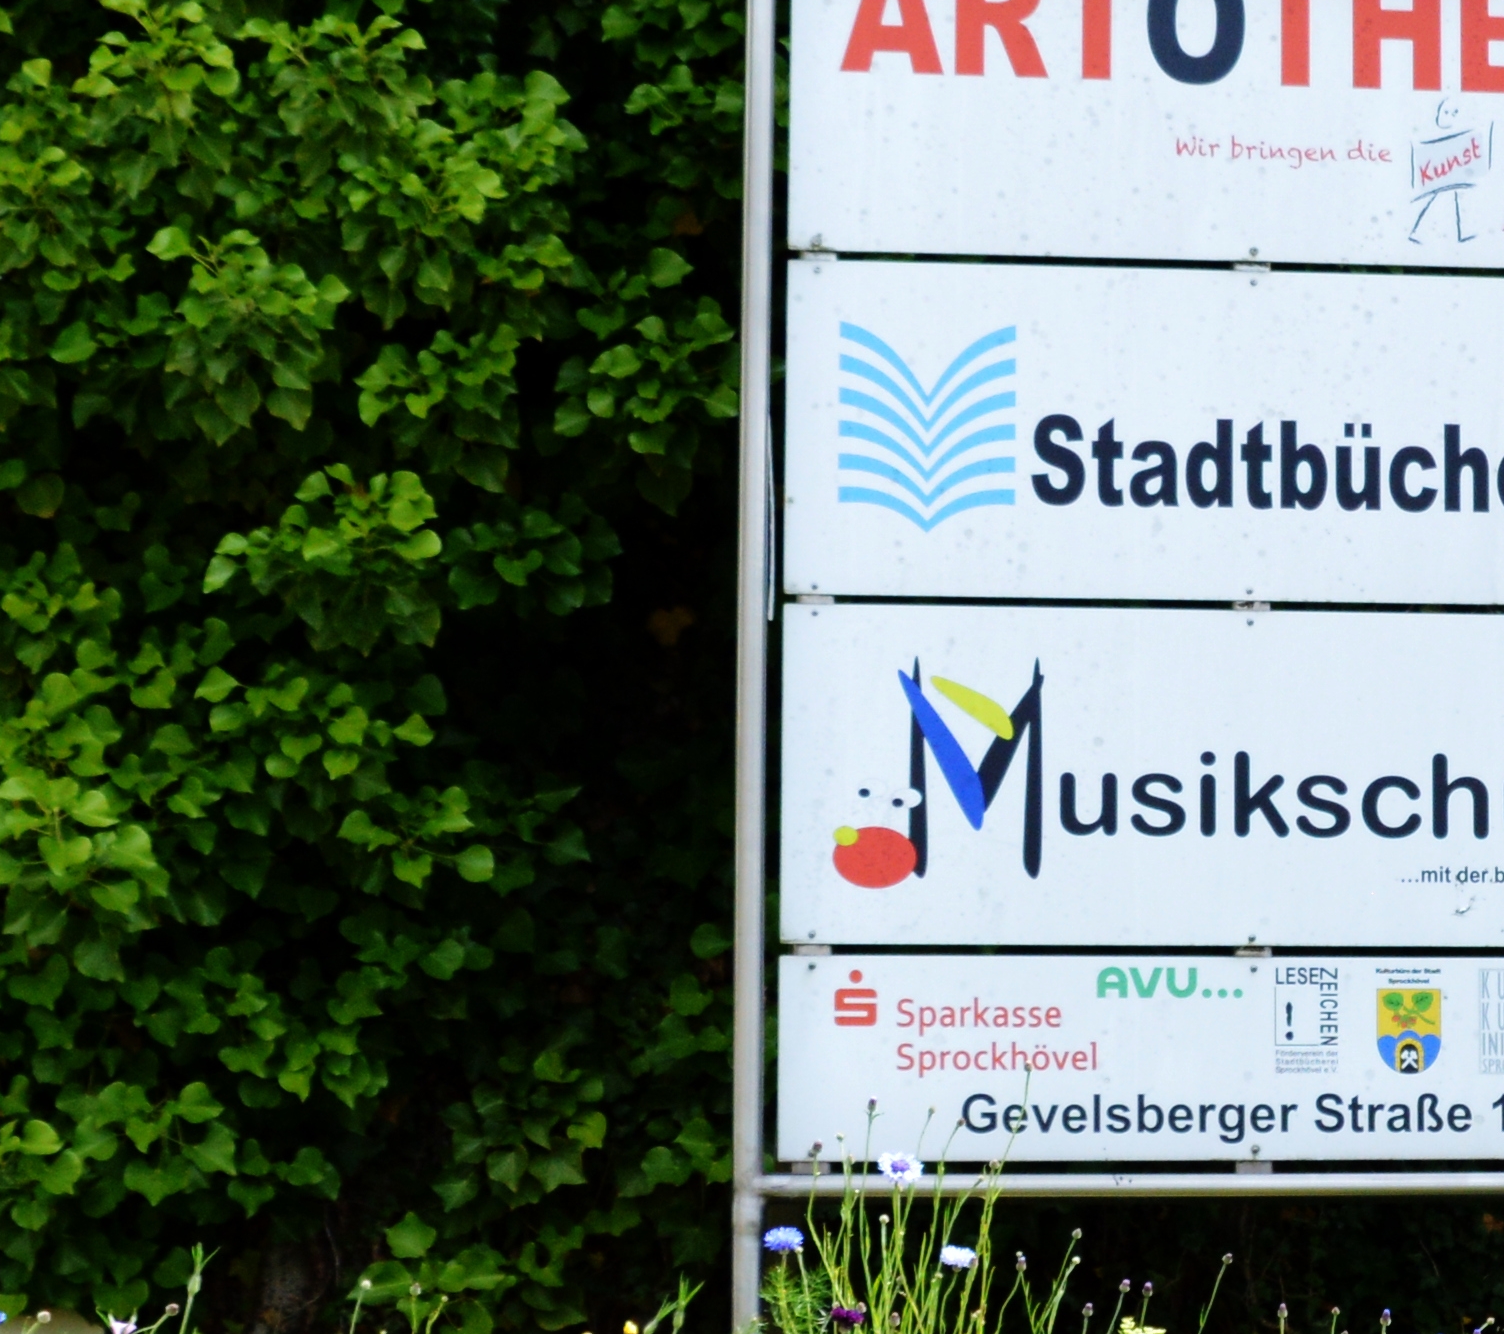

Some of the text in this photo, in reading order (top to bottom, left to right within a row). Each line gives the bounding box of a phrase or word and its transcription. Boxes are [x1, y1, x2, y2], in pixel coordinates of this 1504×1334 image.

[1176, 135, 1392, 169] Wir bringen die
[1420, 135, 1481, 186] Kunst
[1456, 866, 1488, 884] der
[1276, 967, 1319, 985] LESE
[1388, 977, 1430, 986] Sprockhövel
[897, 997, 1061, 1036] Sparkasse
[1319, 968, 1338, 1045] ZEICHEN
[897, 1042, 1098, 1077] Sprockhövel
[1276, 1049, 1338, 1058] Förderverein der
[1276, 1058, 1338, 1066] Stadtbücherei
[1276, 1066, 1323, 1075] Sprockhövel
[962, 1093, 1298, 1143] Gevelsberger
[1315, 1093, 1472, 1132] Straße
